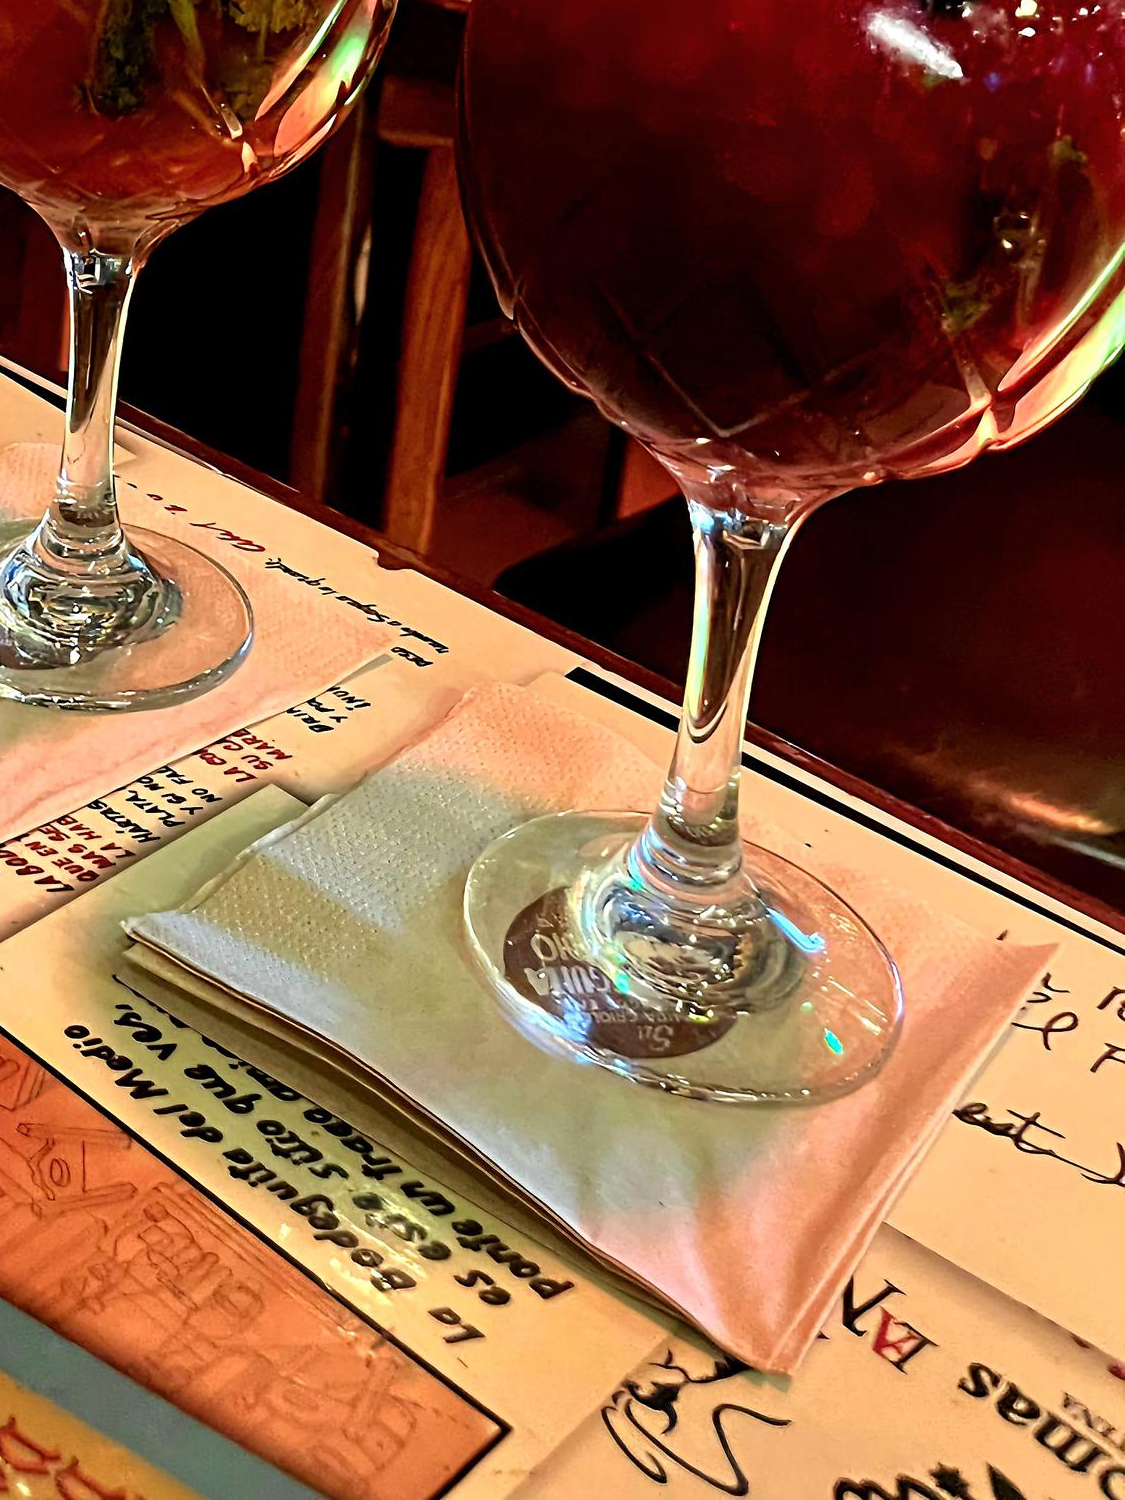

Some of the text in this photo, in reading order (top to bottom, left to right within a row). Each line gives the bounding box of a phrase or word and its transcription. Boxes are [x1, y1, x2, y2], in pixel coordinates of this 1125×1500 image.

[222, 766, 258, 783] LA
[179, 806, 203, 816] Y
[191, 787, 223, 804] NO
[24, 840, 100, 882] QUE EN
[100, 842, 137, 859] LA
[33, 874, 75, 893] LA
[183, 1062, 260, 1116] que
[62, 1023, 488, 1345] La Bodeguita del Medio
[399, 1180, 457, 1218] un
[451, 1217, 575, 1302] ponte
[453, 1268, 514, 1307] es
